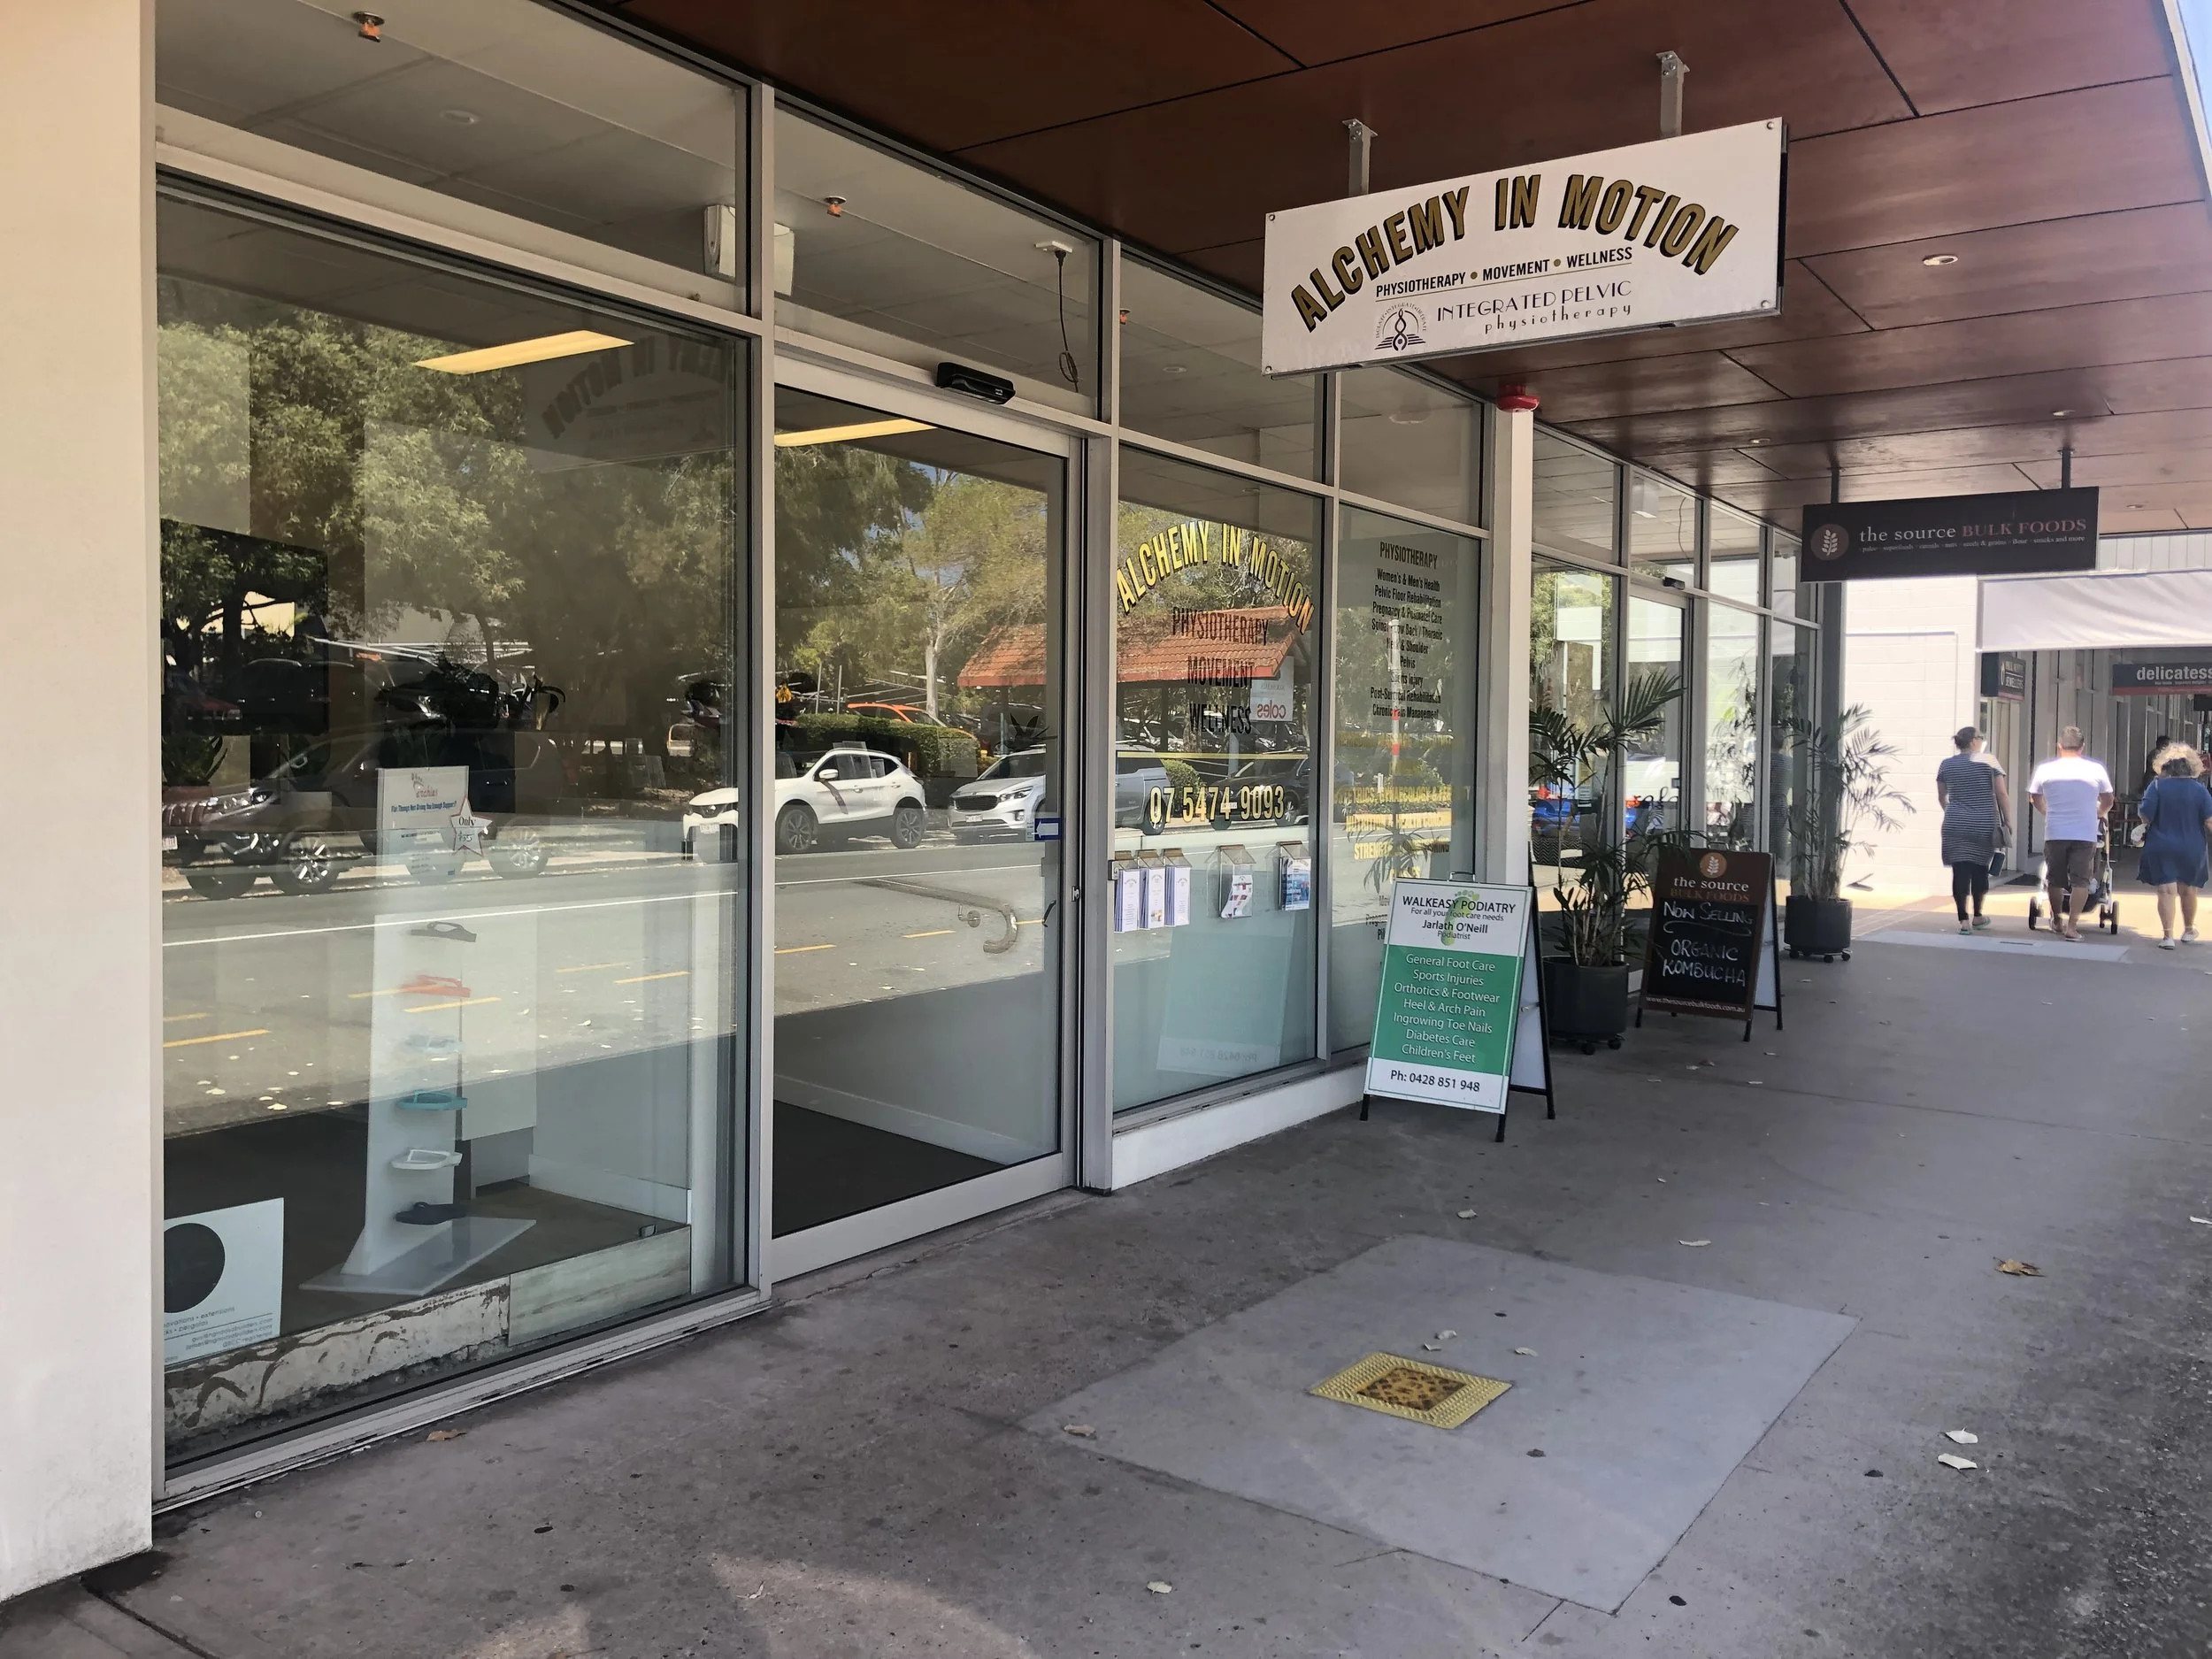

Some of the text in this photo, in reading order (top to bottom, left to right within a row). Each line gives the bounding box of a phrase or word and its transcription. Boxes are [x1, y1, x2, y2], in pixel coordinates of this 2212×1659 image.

[1290, 173, 1739, 333] ALCHEMY IN MOTION
[1376, 247, 1633, 297] PHYSIOTHERAPY MOVEMENT WELLNESS
[1437, 280, 1632, 322] INTEGRATED PELVIC
[1485, 303, 1632, 334] physiotherapy
[1859, 518, 2087, 542] the source BULK FOODS
[1379, 541, 1438, 570] PHYSIOTHERAPY
[1117, 520, 1315, 635] ALCHEMY IN MOTION
[1377, 567, 1440, 592] Women's & Men's Health
[1374, 584, 1441, 608] Pelvic Floor Rehabilitation
[1372, 601, 1400, 618] Pregnancy
[1401, 607, 1405, 618] &
[1431, 611, 1442, 625] Care
[1171, 606, 1269, 647] PHYSIOTHERAPY
[1371, 618, 1388, 633] Spinal
[1406, 624, 1417, 636] Back
[1422, 626, 1442, 641] Thoracic
[1401, 640, 1405, 651] &
[1406, 640, 1429, 654] Shoulder
[1187, 656, 1255, 688] MOVEMENT
[1400, 656, 1415, 669] Pelvis
[1189, 702, 1253, 735] WELLNESS
[1150, 787, 1175, 824] 07
[458, 817, 476, 827] Only
[1670, 887, 1750, 902] BULK FOODS
[1673, 877, 1749, 893] the source
[1402, 895, 1459, 910] WALKEASY
[1461, 900, 1516, 914] PODIATRY
[1422, 919, 1488, 933] Jarlath O'Neill
[1432, 910, 1448, 919] your
[1449, 910, 1464, 918] foot
[1482, 913, 1504, 922] needs
[1437, 931, 1471, 941] Podiatrist
[1671, 939, 1739, 961] ORGANIC
[1406, 953, 1495, 972] General Foot Care
[1662, 958, 1747, 987] KOMBUCHA
[1413, 970, 1484, 986] Sports Injuries
[1394, 982, 1500, 1002] Orthotics & Footwear
[1403, 998, 1486, 1017] Heel & Arch Pain
[1394, 1012, 1492, 1033] Ingrowing Toe Nails
[1406, 1029, 1476, 1047] Diabetes Care
[1402, 1043, 1476, 1063] Children's Feet
[1390, 1070, 1480, 1092] Ph: 0428 851 948
